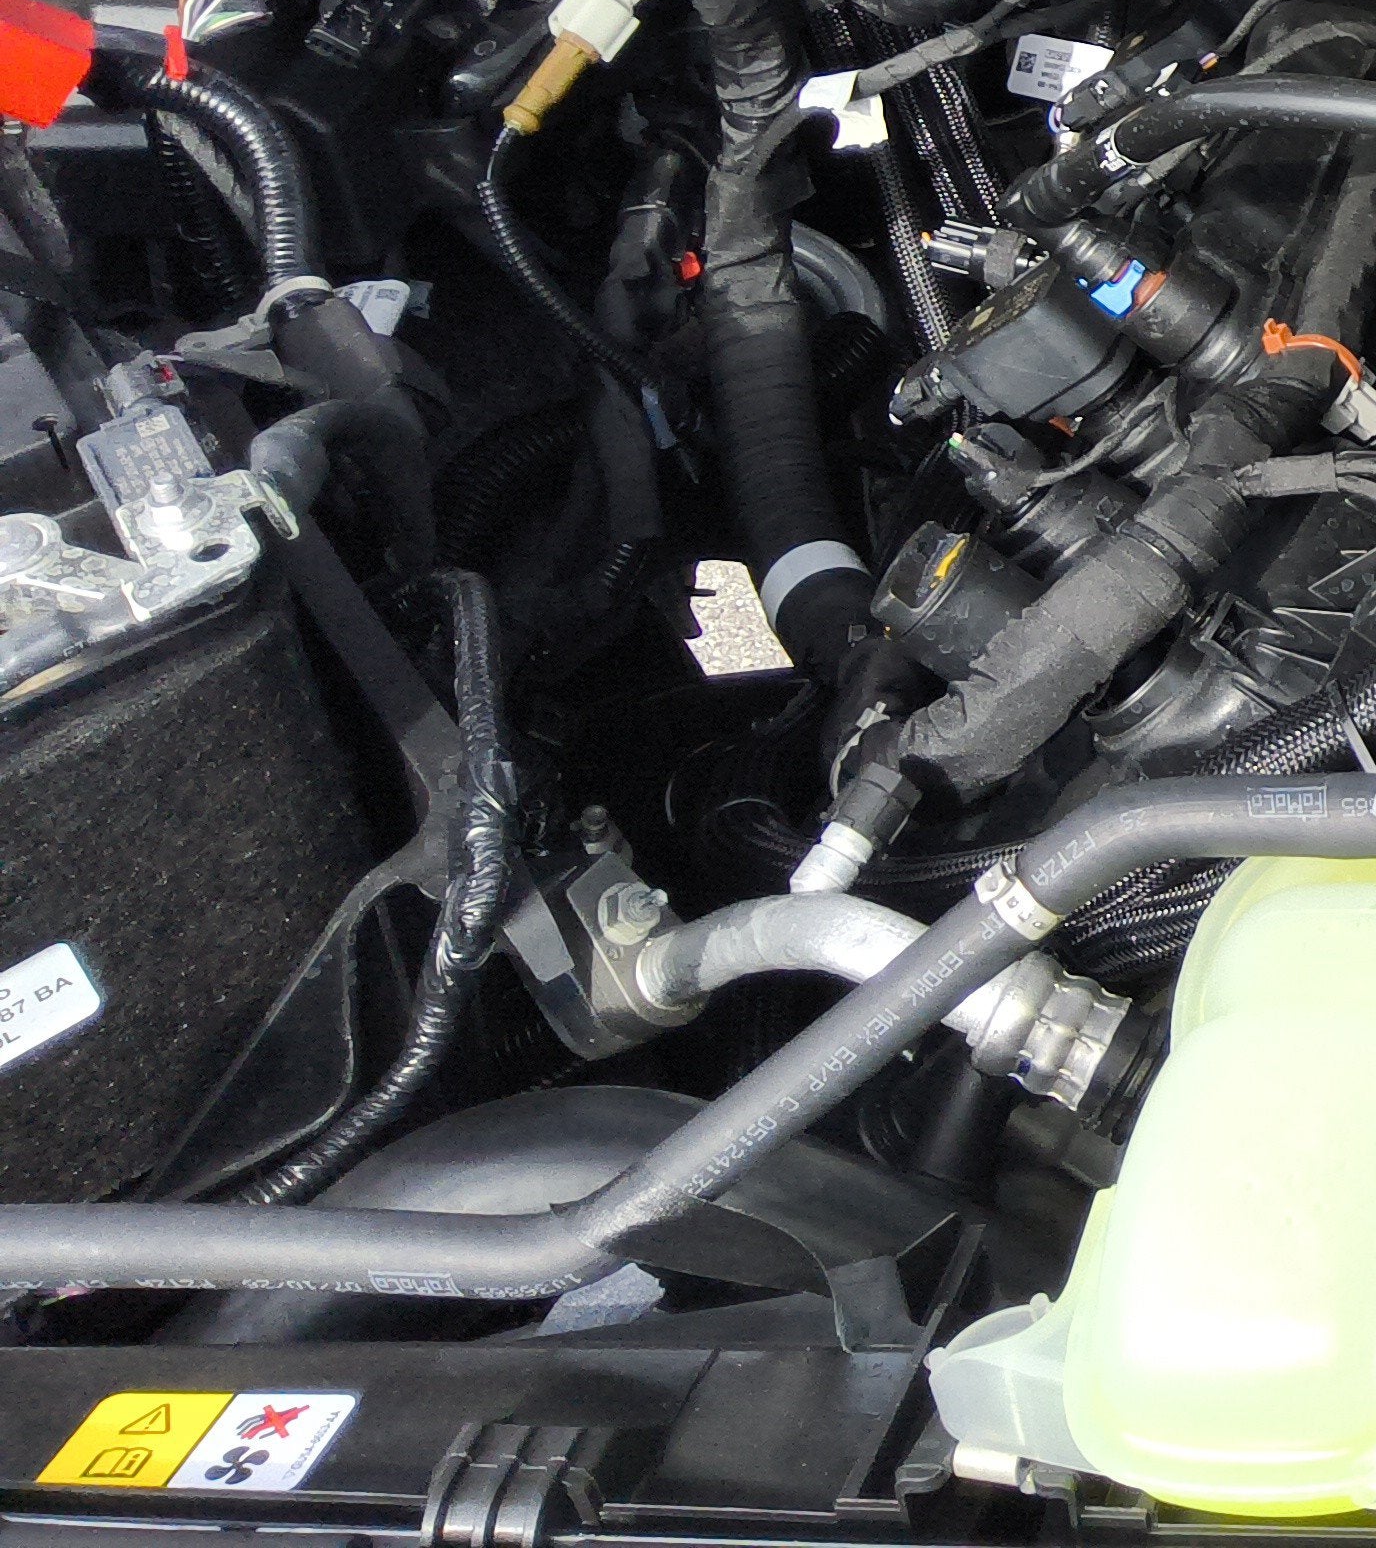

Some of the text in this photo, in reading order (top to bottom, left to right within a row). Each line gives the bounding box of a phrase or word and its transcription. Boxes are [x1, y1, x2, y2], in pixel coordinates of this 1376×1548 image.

[1249, 789, 1326, 817] FoMoCo
[34, 977, 73, 1002] BA
[373, 1273, 455, 1295] FoMoCo
